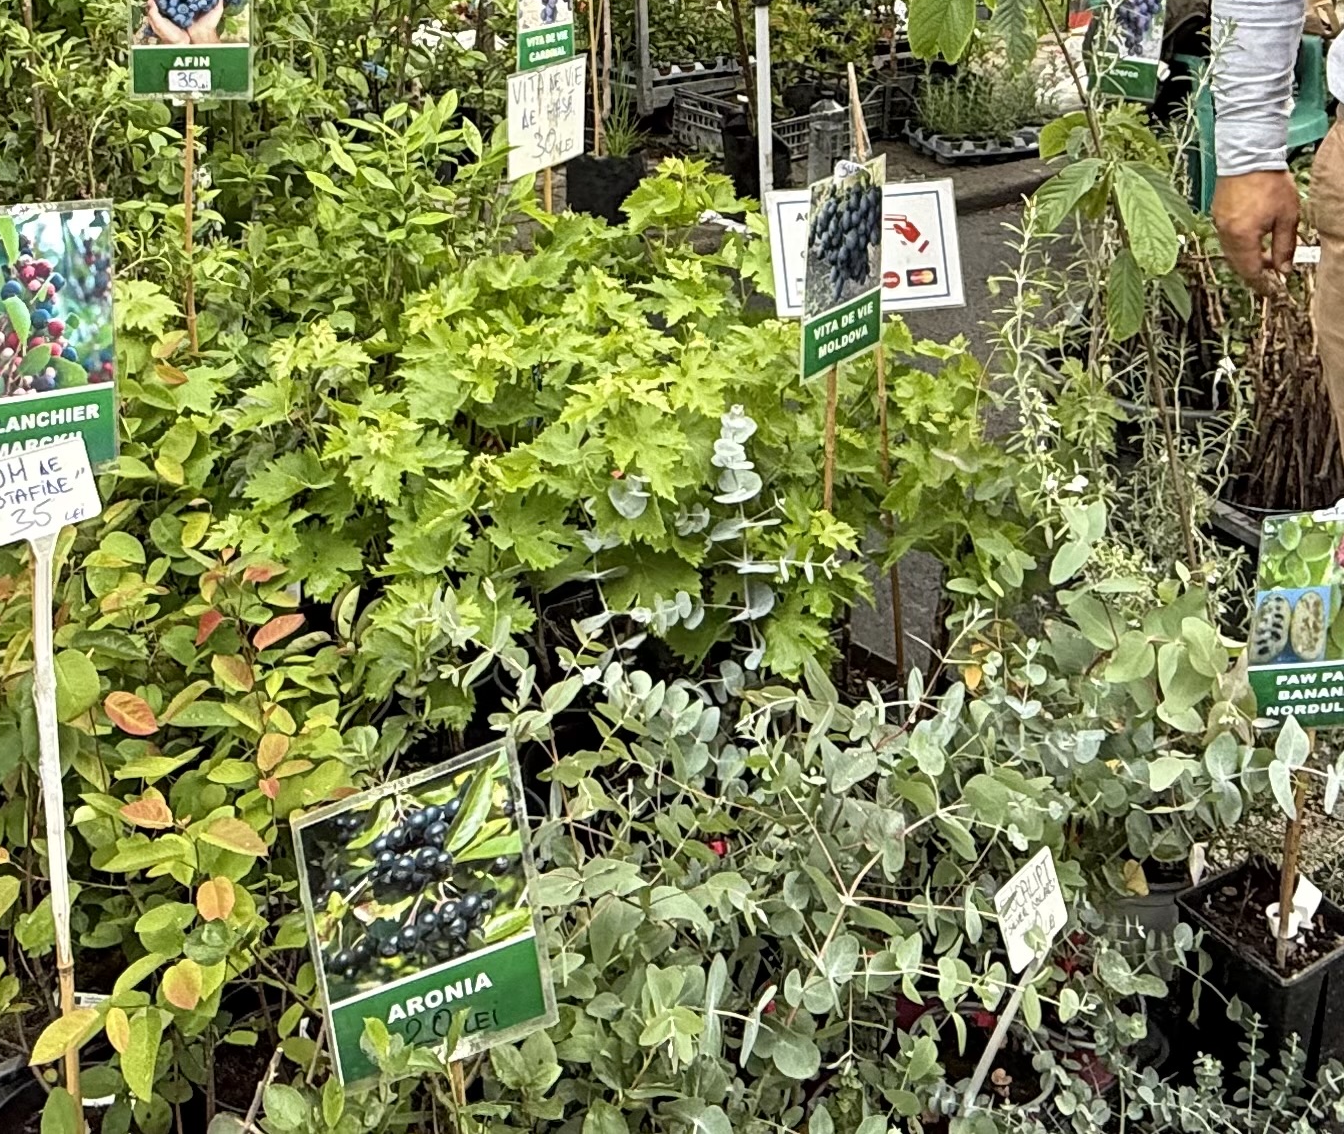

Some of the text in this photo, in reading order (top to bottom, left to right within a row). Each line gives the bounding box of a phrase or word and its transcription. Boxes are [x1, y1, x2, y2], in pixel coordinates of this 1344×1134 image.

[173, 55, 211, 68] AFIN
[176, 71, 199, 89] 35
[813, 300, 875, 341] VITA DE VIE
[817, 324, 870, 361] MOLDOVA
[8, 497, 53, 537] 35
[1276, 673, 1317, 686] PAW
[387, 972, 494, 1025] ARONIA
